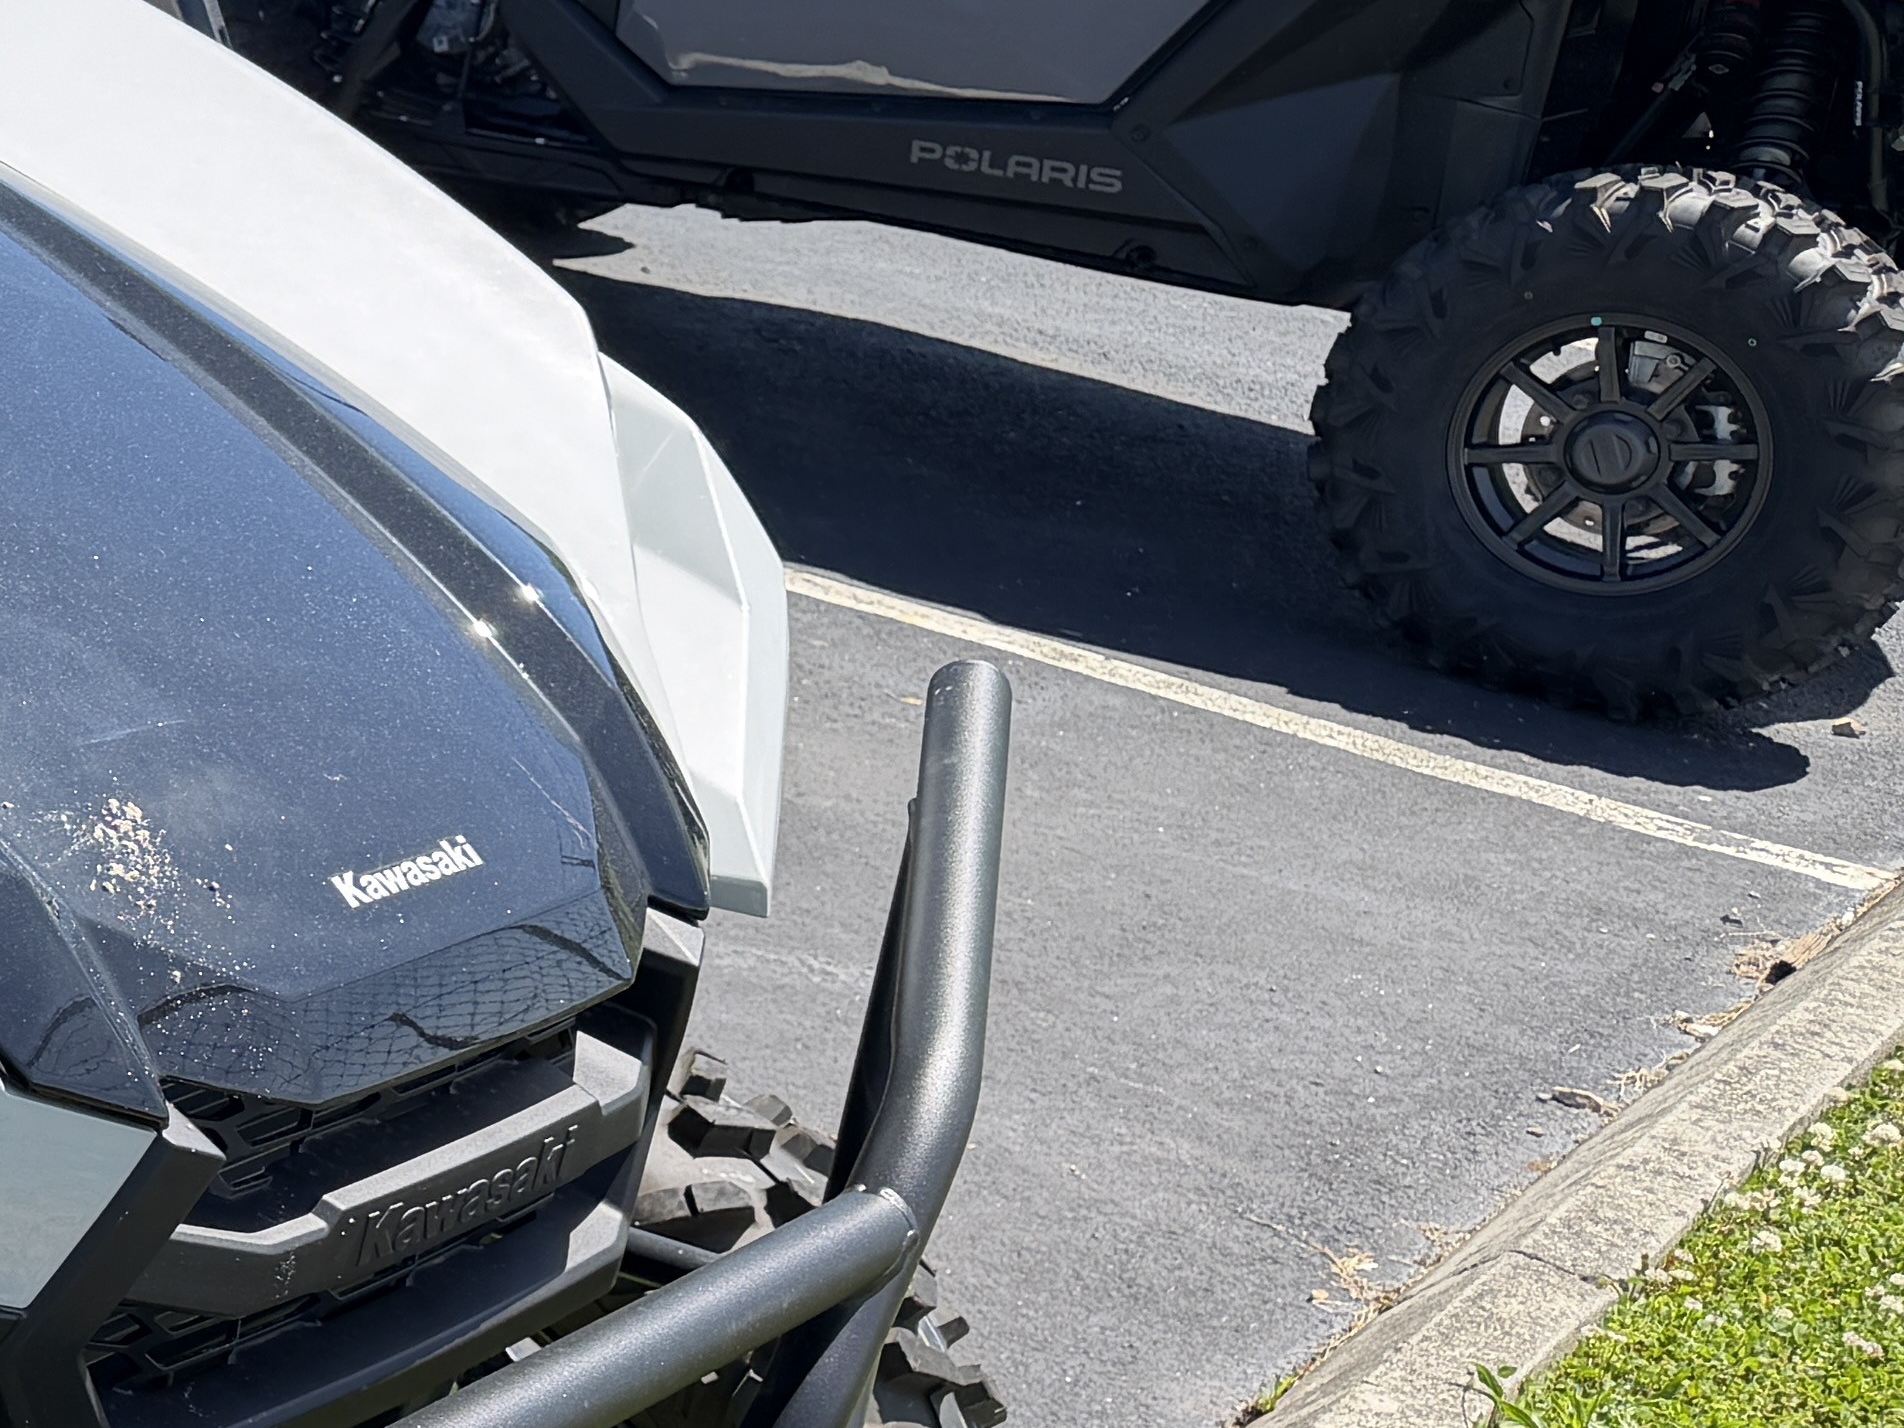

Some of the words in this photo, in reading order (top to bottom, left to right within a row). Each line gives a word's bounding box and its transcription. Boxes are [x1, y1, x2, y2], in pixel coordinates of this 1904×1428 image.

[910, 139, 1123, 194] POLARIS
[330, 834, 484, 909] Kawasaki
[356, 1124, 580, 1270] Kawasaki
